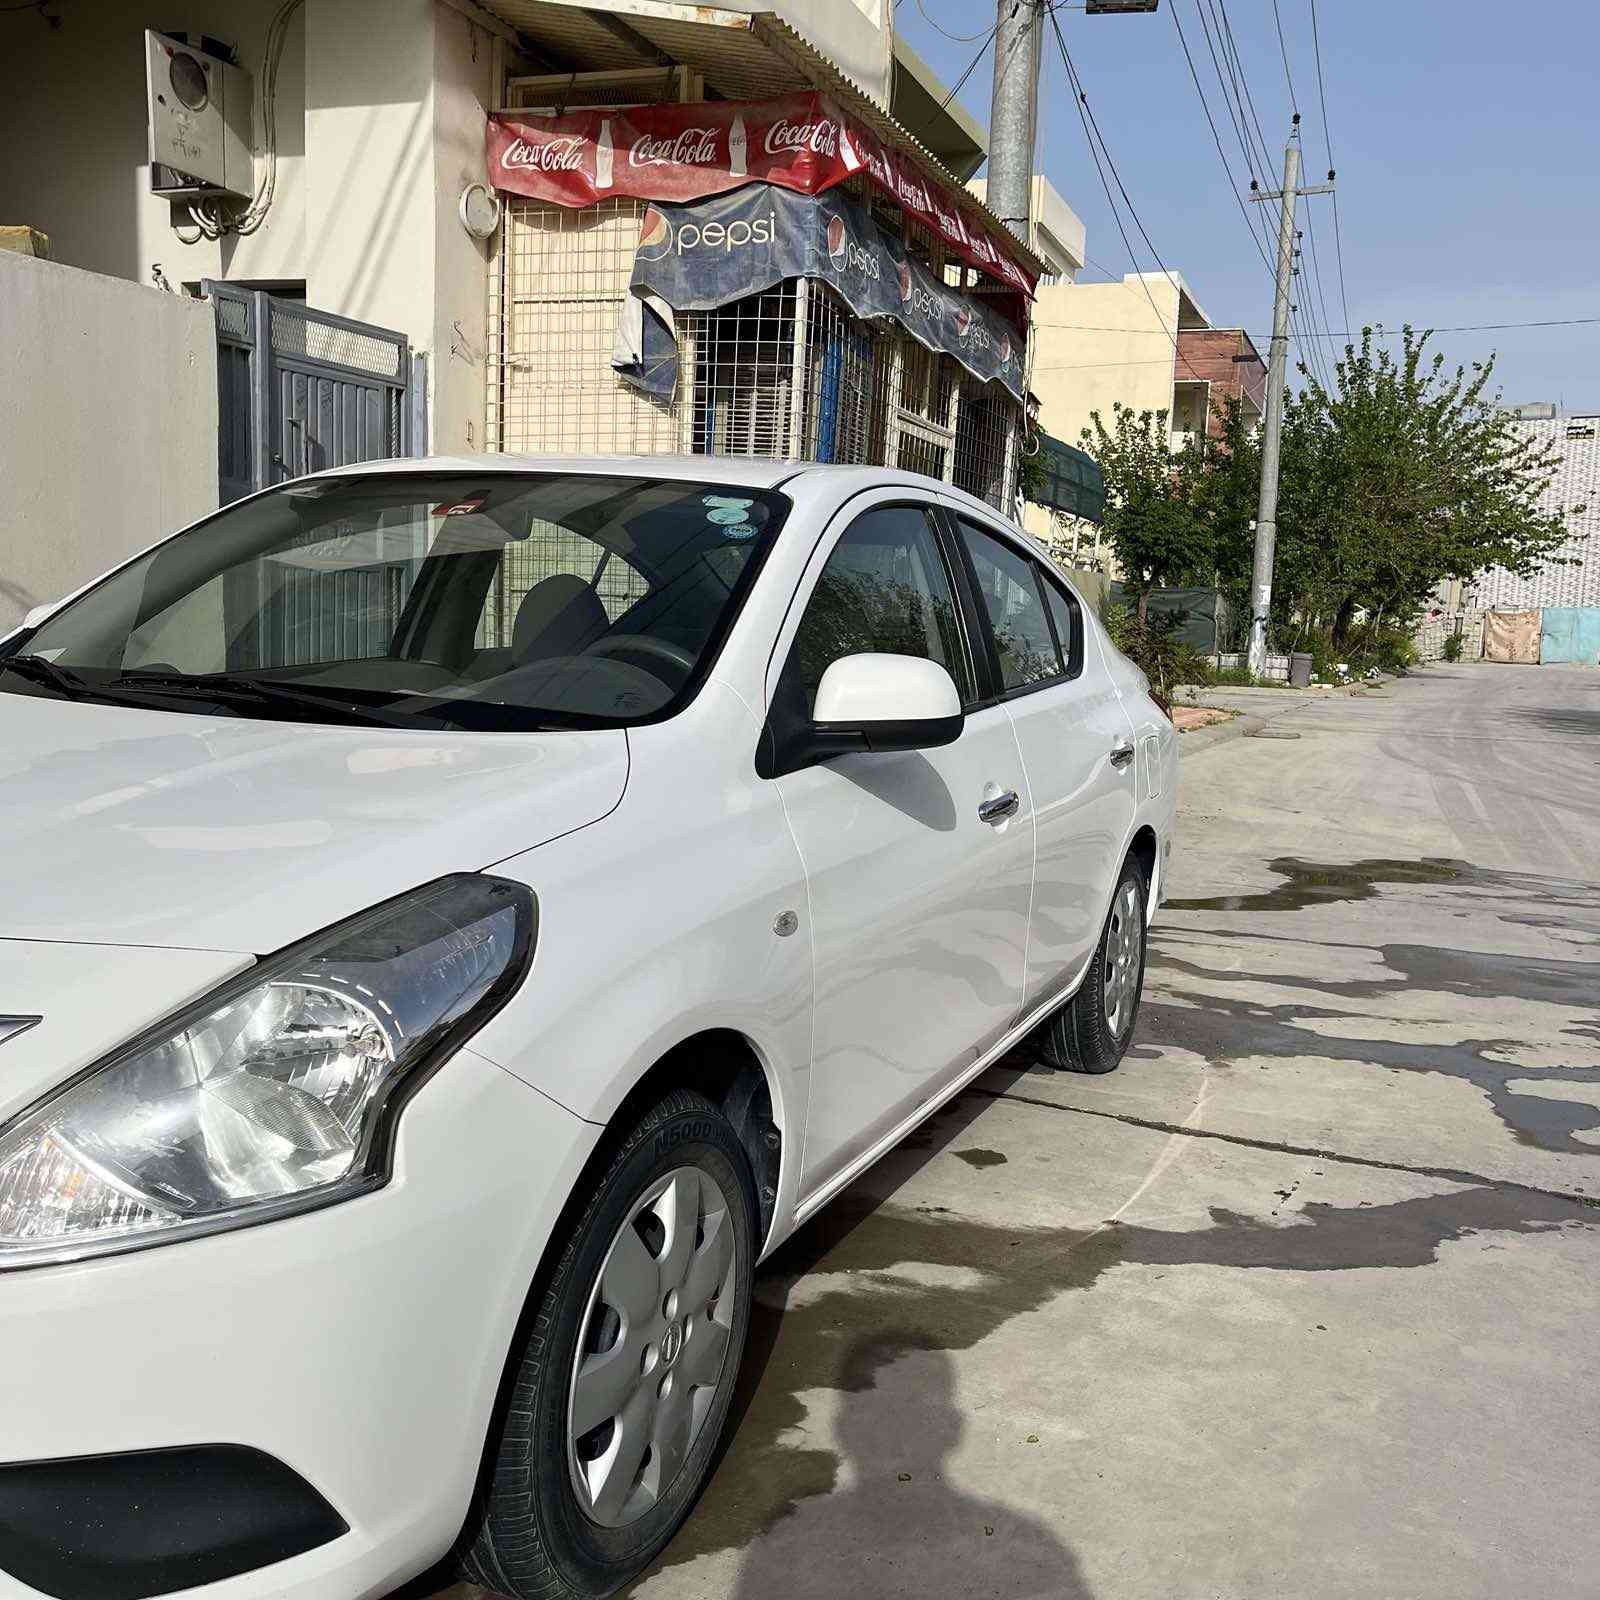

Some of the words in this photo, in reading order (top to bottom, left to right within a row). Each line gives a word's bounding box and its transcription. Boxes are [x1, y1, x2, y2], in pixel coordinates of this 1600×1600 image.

[501, 136, 588, 172] Coca-Cola
[629, 127, 720, 168] Coca-Cola
[765, 118, 836, 157] Coca-Cola
[677, 211, 776, 256] pepsi
[848, 241, 880, 281] pepsi
[913, 288, 943, 321] pepsi
